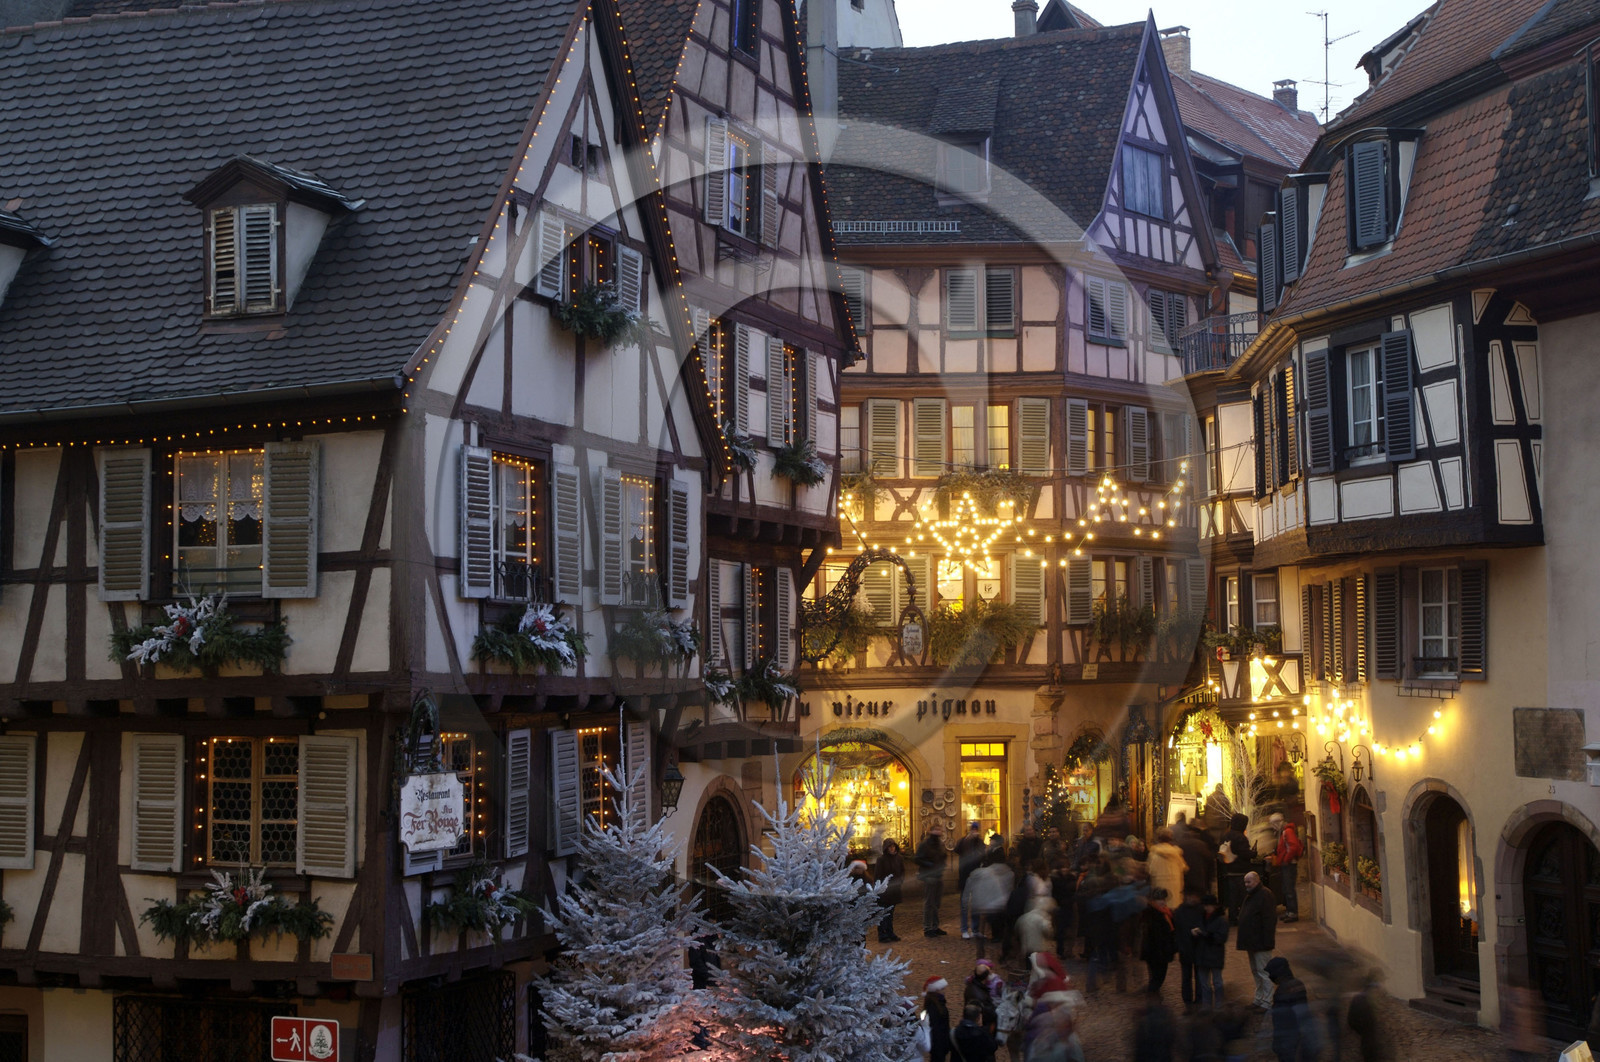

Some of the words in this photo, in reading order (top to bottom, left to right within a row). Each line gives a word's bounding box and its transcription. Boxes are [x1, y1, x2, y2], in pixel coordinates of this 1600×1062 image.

[916, 692, 997, 722] pignon
[415, 788, 451, 803] Restaurant
[403, 811, 426, 837] Fer
[425, 808, 460, 837] Rouge
